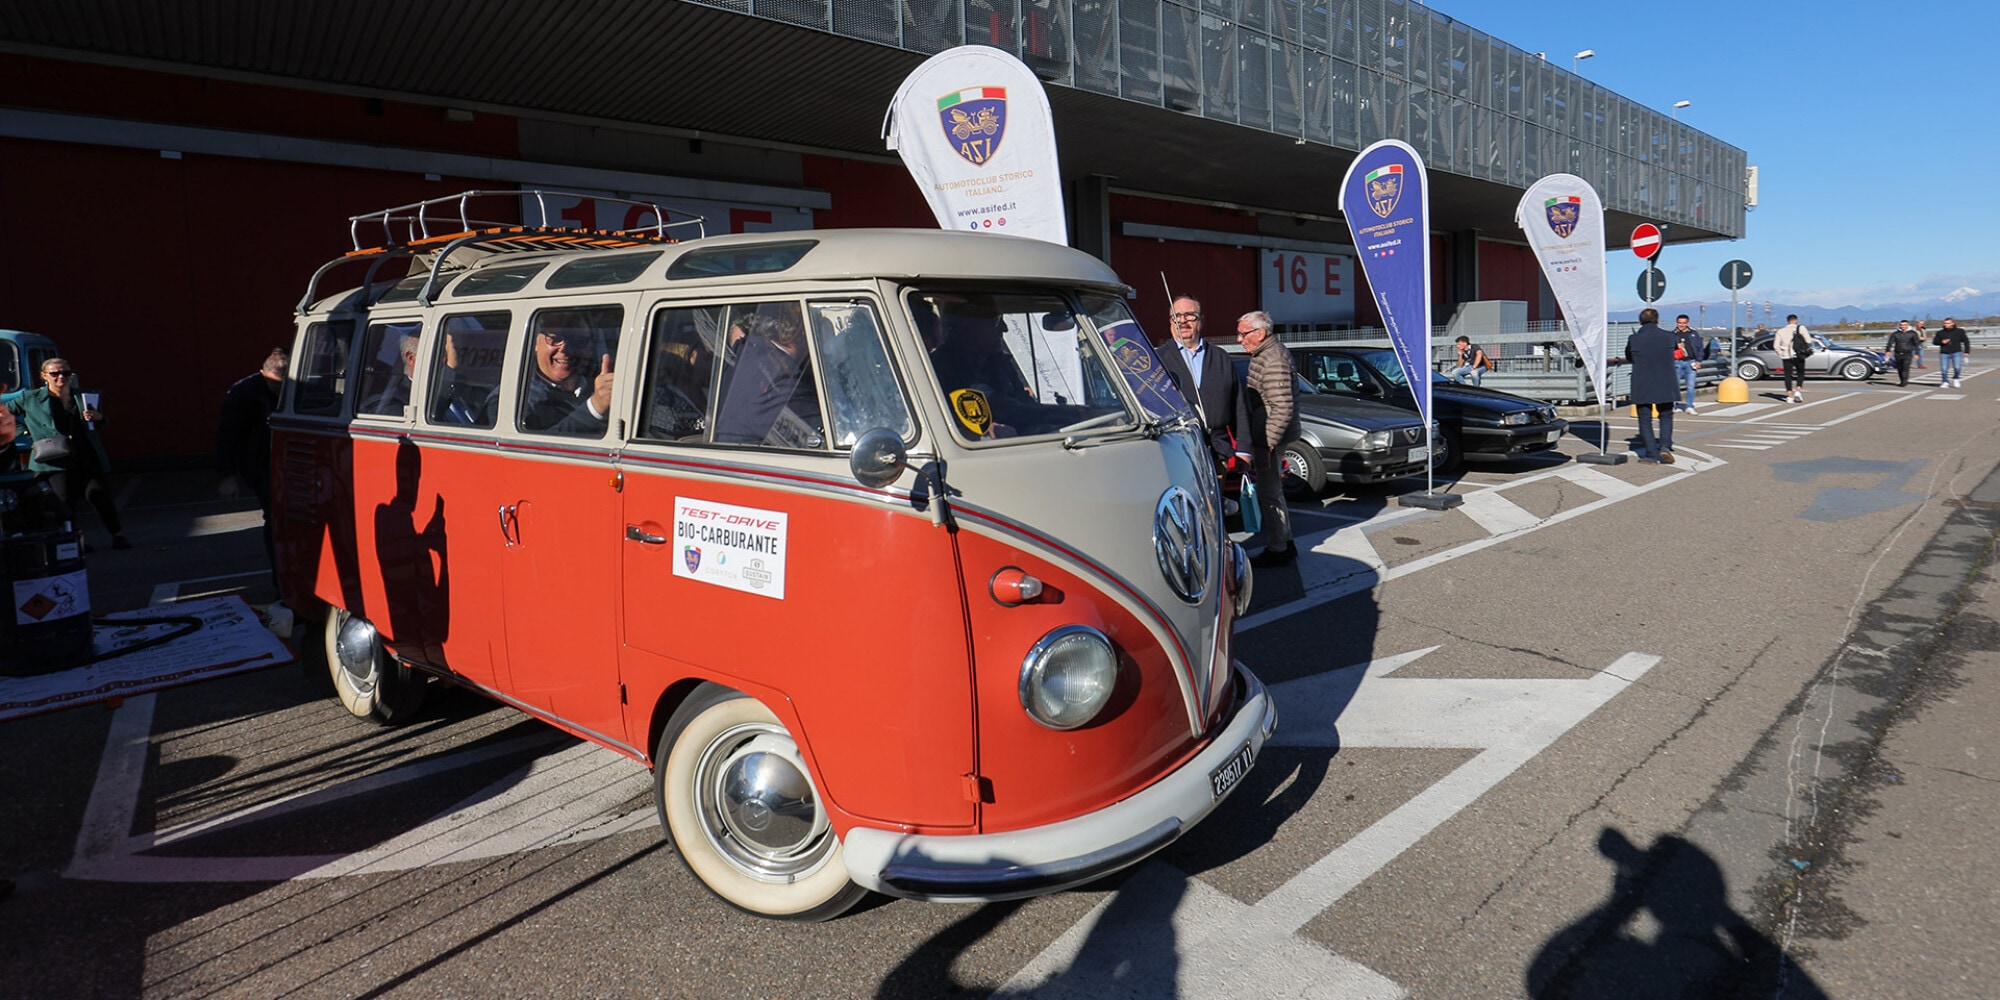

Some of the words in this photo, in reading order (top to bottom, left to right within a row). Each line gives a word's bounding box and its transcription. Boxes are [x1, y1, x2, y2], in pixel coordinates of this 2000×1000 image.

[934, 175, 998, 191] AUTOMOTOCLUB
[998, 169, 1034, 183] STORICO
[965, 185, 1003, 197] ITALIANO
[957, 202, 1017, 217] www.asifed.it
[1273, 253, 1307, 295] 16
[1325, 257, 1342, 296] E
[681, 506, 781, 531] TEST-DRIVE
[678, 521, 778, 555] BIO-CARBURANTE
[1214, 757, 1242, 795] 239517
